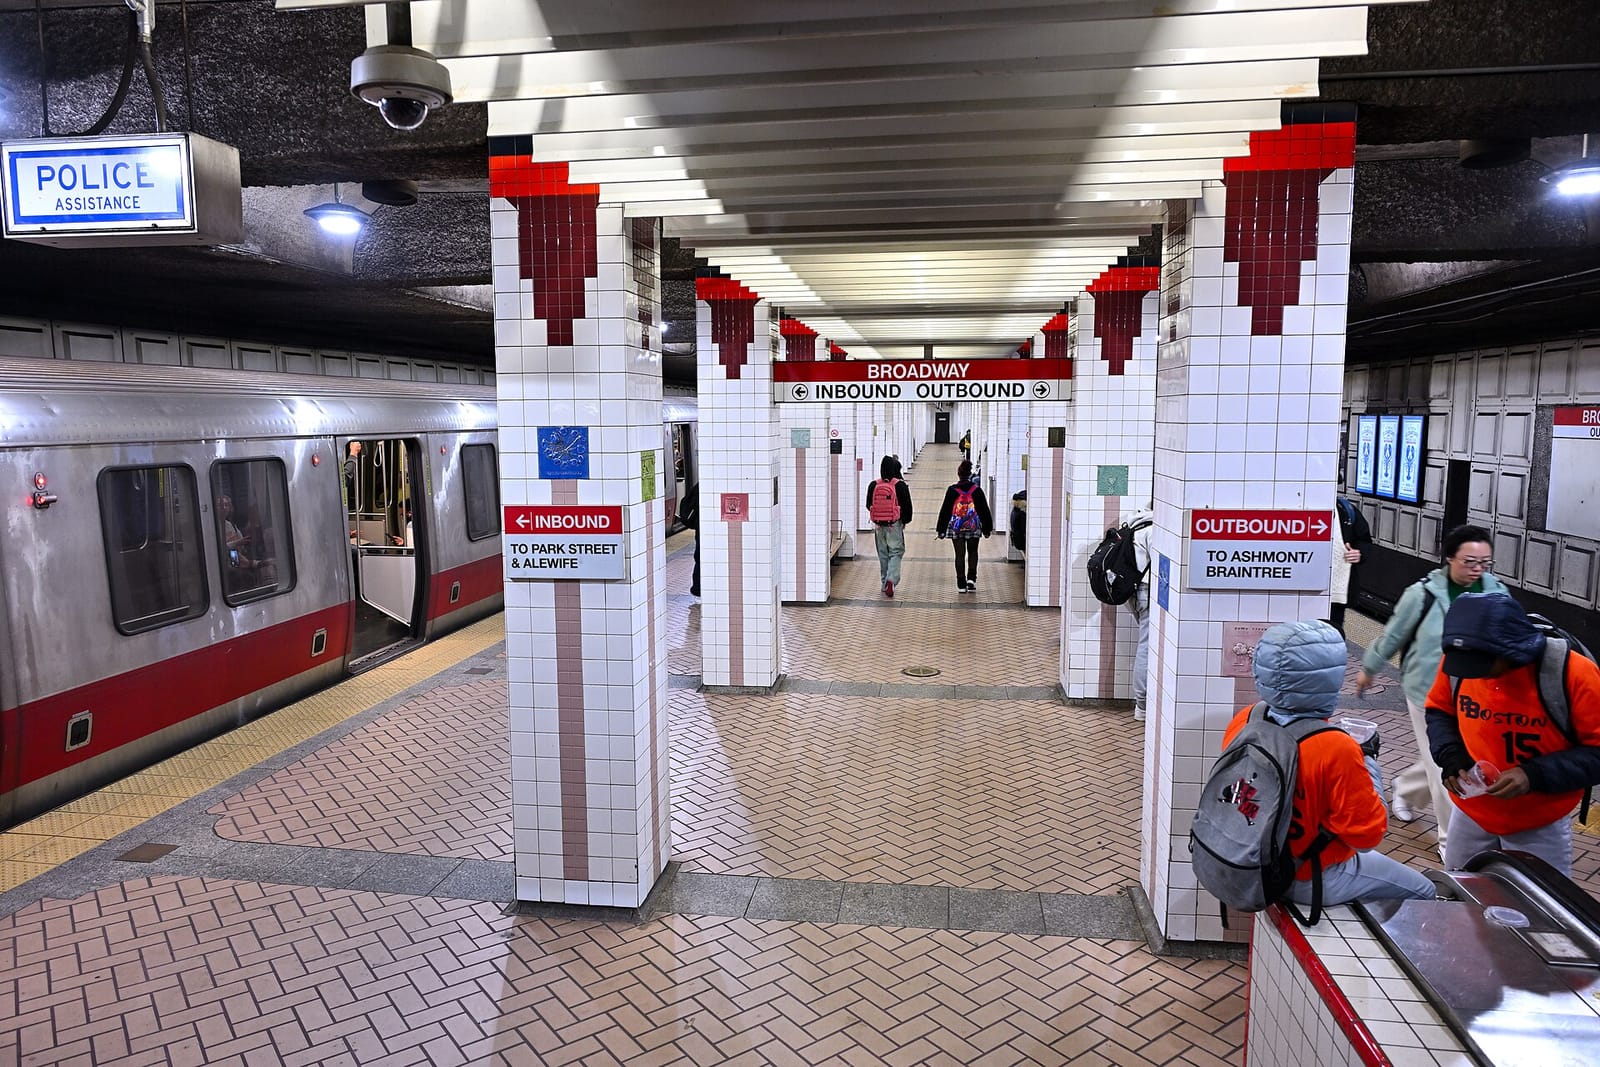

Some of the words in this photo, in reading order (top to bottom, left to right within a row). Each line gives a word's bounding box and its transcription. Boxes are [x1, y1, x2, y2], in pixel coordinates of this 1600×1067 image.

[37, 162, 155, 191] POLICE
[55, 196, 141, 211] ASSISTANCE
[867, 363, 970, 379] BROADWAY
[815, 383, 901, 399] INBOUND
[916, 383, 1025, 398] OUTBOUND
[535, 515, 610, 529] INBOUND
[1195, 518, 1306, 535] OUTBOUND
[510, 543, 529, 555] TO
[531, 543, 565, 555] PARK
[568, 543, 618, 555] STREET
[1206, 550, 1228, 562] TO
[1230, 550, 1314, 563] ASHMONT/
[511, 558, 520, 569] &
[523, 558, 579, 569] ALEWIFE
[1206, 566, 1292, 579] BRAINTREE
[1501, 730, 1541, 764] 15
